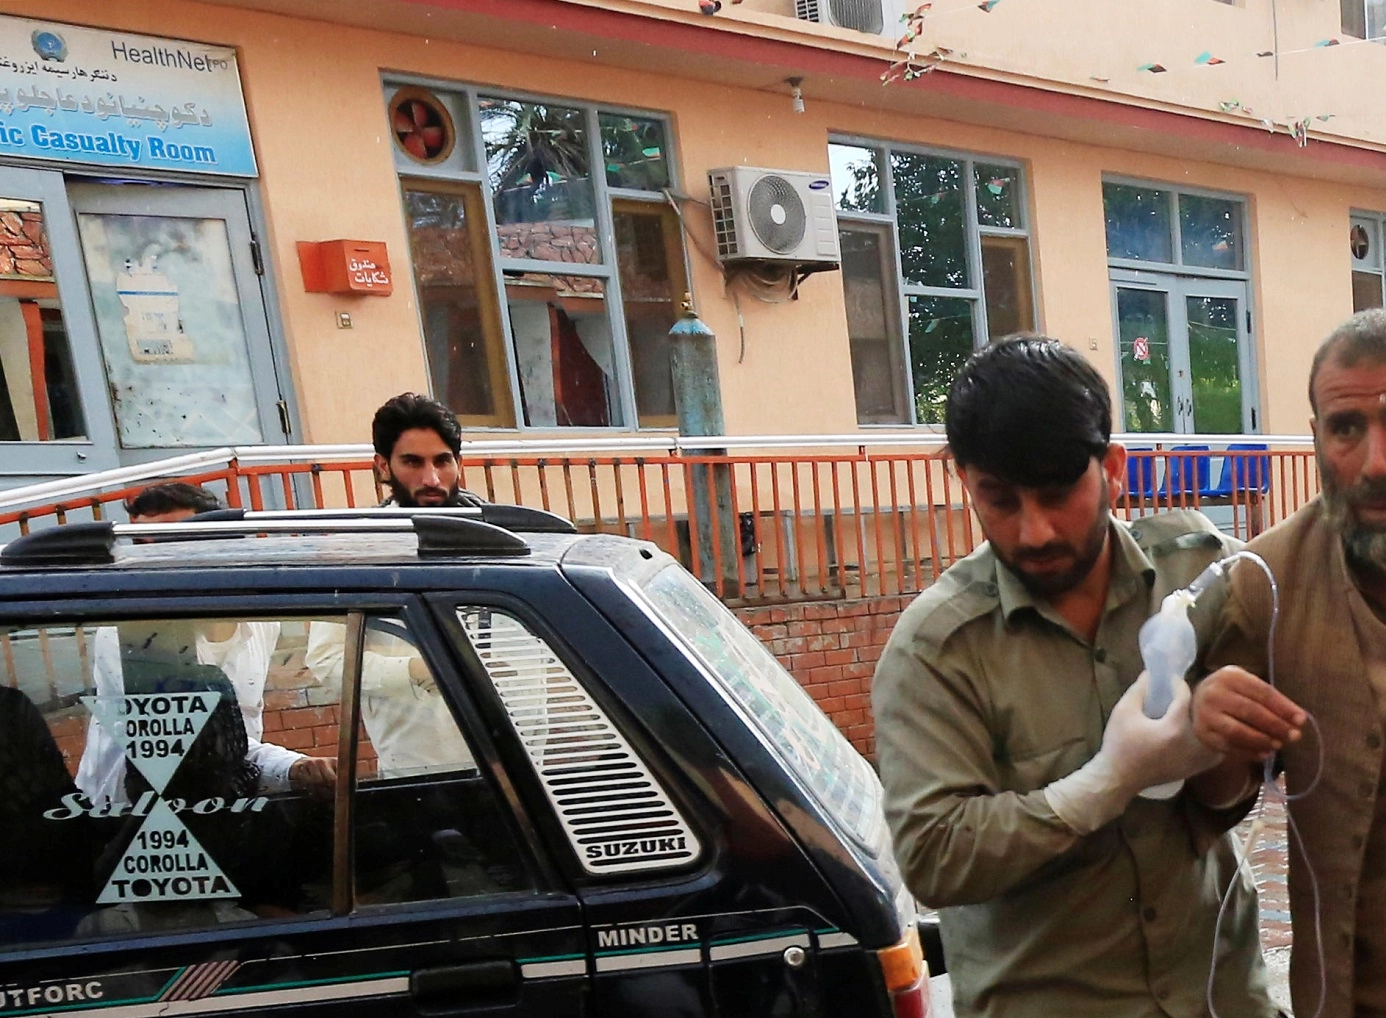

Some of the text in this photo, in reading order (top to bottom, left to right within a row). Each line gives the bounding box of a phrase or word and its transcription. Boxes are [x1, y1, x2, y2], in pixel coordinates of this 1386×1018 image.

[111, 40, 213, 74] HealthNet
[32, 125, 141, 161] Casualty
[147, 136, 216, 163] Room
[354, 271, 389, 287] شکایات
[94, 696, 208, 716] OYOTA
[126, 739, 185, 759] 1994
[136, 829, 190, 851] 1994
[586, 837, 686, 858] SUZUKI
[123, 853, 209, 874] COROLLA
[111, 875, 231, 898] TOYOTA
[598, 923, 699, 948] MINDER
